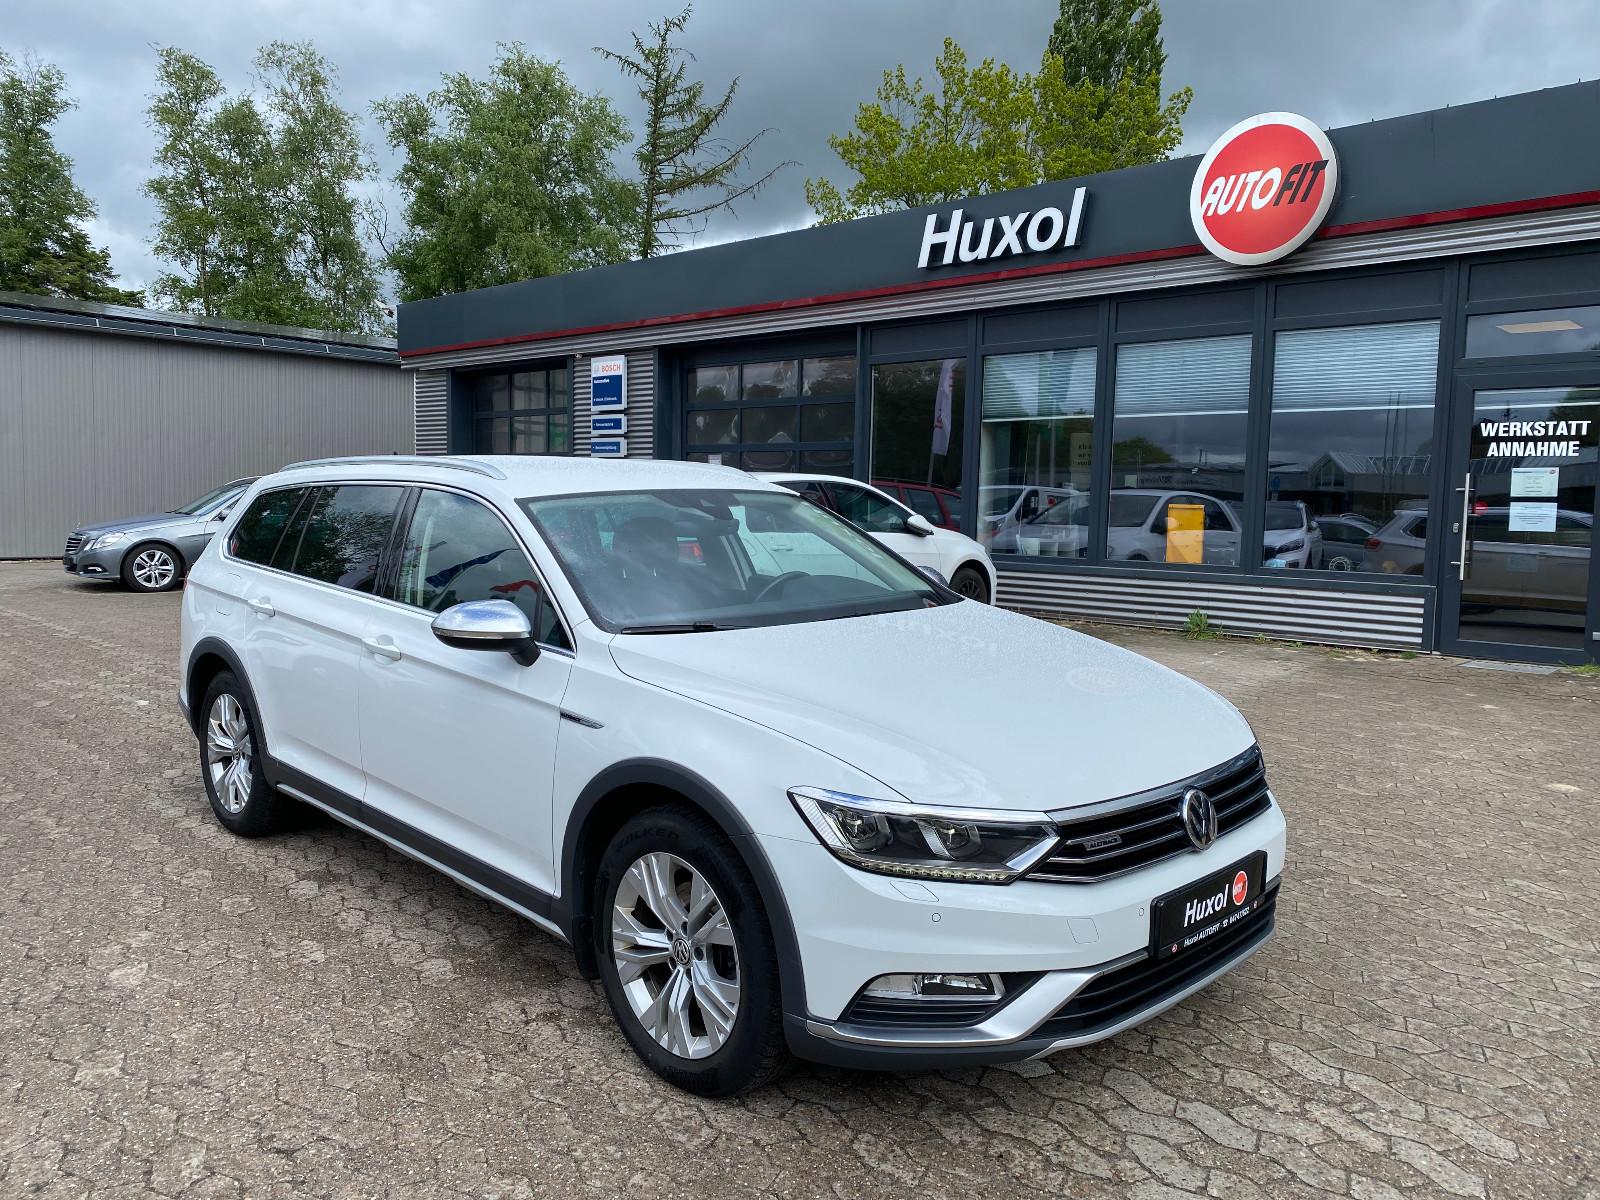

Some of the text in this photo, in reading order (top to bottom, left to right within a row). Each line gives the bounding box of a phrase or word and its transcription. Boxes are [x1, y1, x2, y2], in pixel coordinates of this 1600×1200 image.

[1201, 159, 1329, 217] AUTOFIT
[917, 186, 1087, 269] Huxol
[601, 364, 621, 373] BOSCH
[1480, 420, 1592, 437] WERKSTATT
[1487, 441, 1580, 457] ANNAHME
[1183, 884, 1230, 928] Huxol
